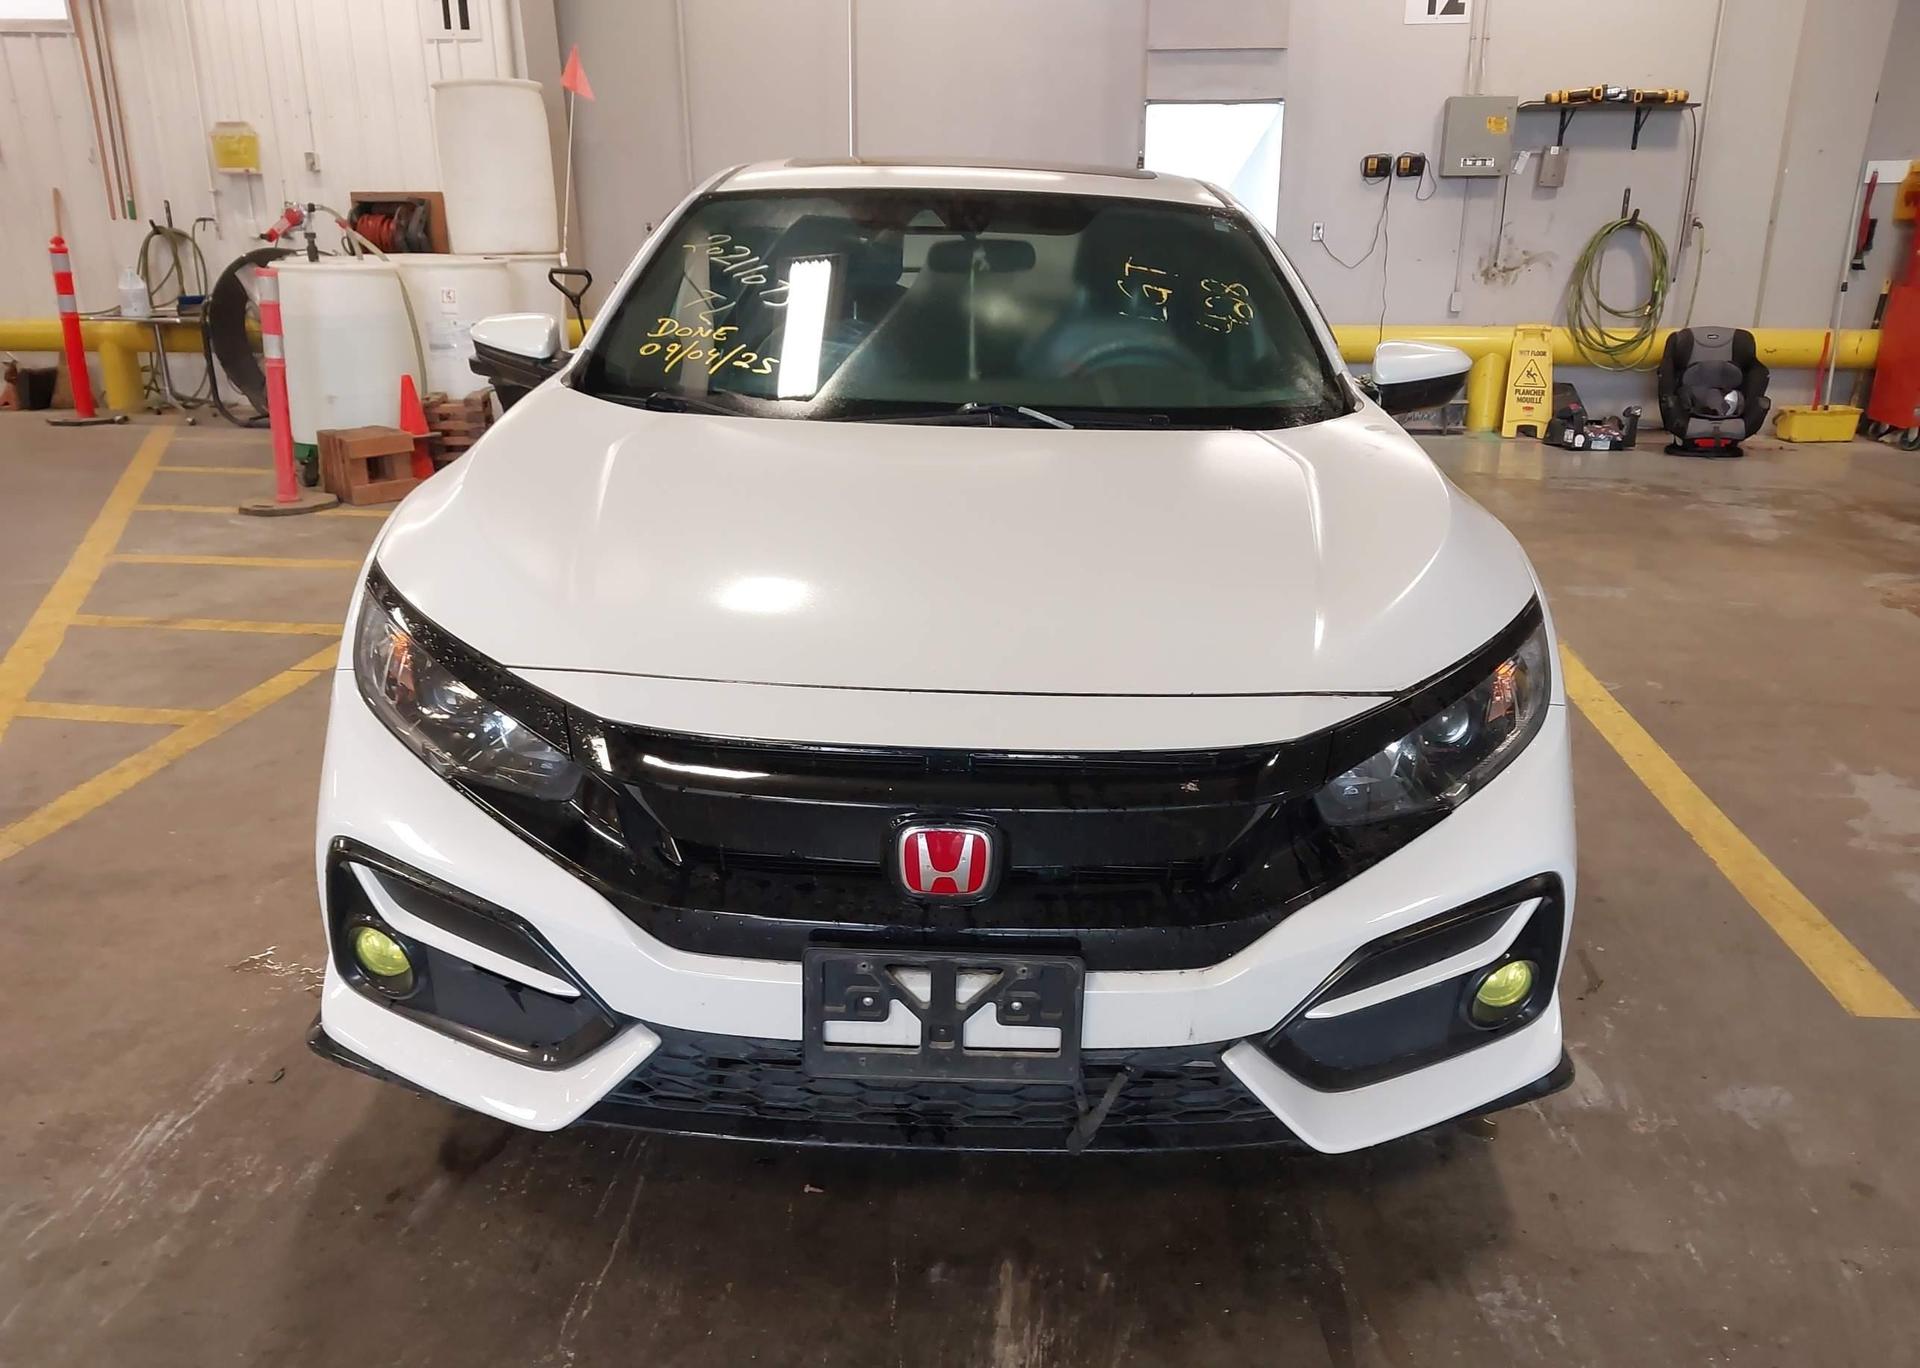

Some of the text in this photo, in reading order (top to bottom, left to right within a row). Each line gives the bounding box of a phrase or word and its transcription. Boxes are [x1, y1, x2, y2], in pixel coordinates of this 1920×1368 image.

[647, 318, 739, 341] DONE
[639, 340, 780, 375] 09/04/25
[1514, 388, 1546, 397] PLANCHER
